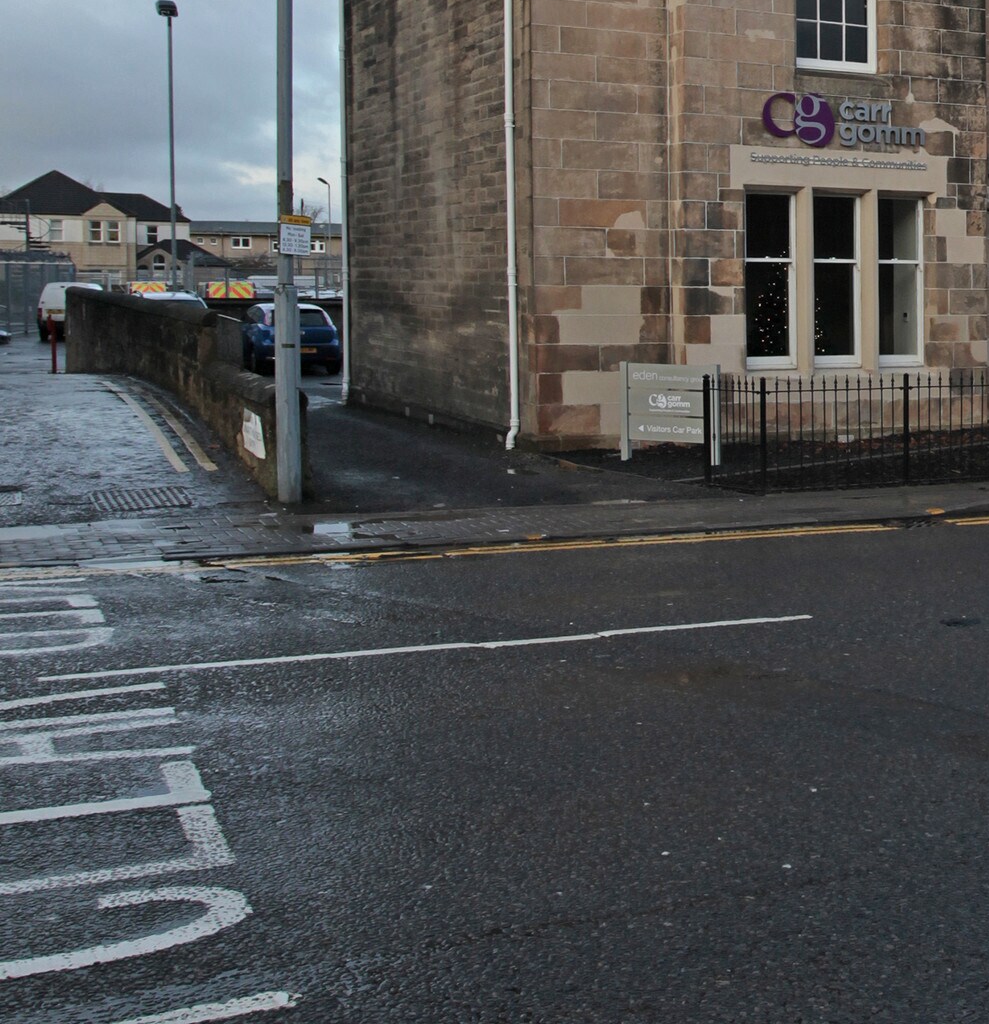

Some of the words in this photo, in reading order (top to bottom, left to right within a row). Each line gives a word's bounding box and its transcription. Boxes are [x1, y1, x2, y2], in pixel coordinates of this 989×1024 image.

[839, 99, 892, 123] carr
[839, 125, 926, 147] gomm
[750, 151, 810, 166] Supporting
[812, 155, 849, 168] People
[852, 156, 860, 167] &
[862, 157, 928, 171] Communities
[632, 370, 658, 381] eden
[667, 401, 691, 409] gomm
[646, 424, 672, 434] Visitors
[672, 425, 685, 434] Car
[686, 426, 703, 435] Park
